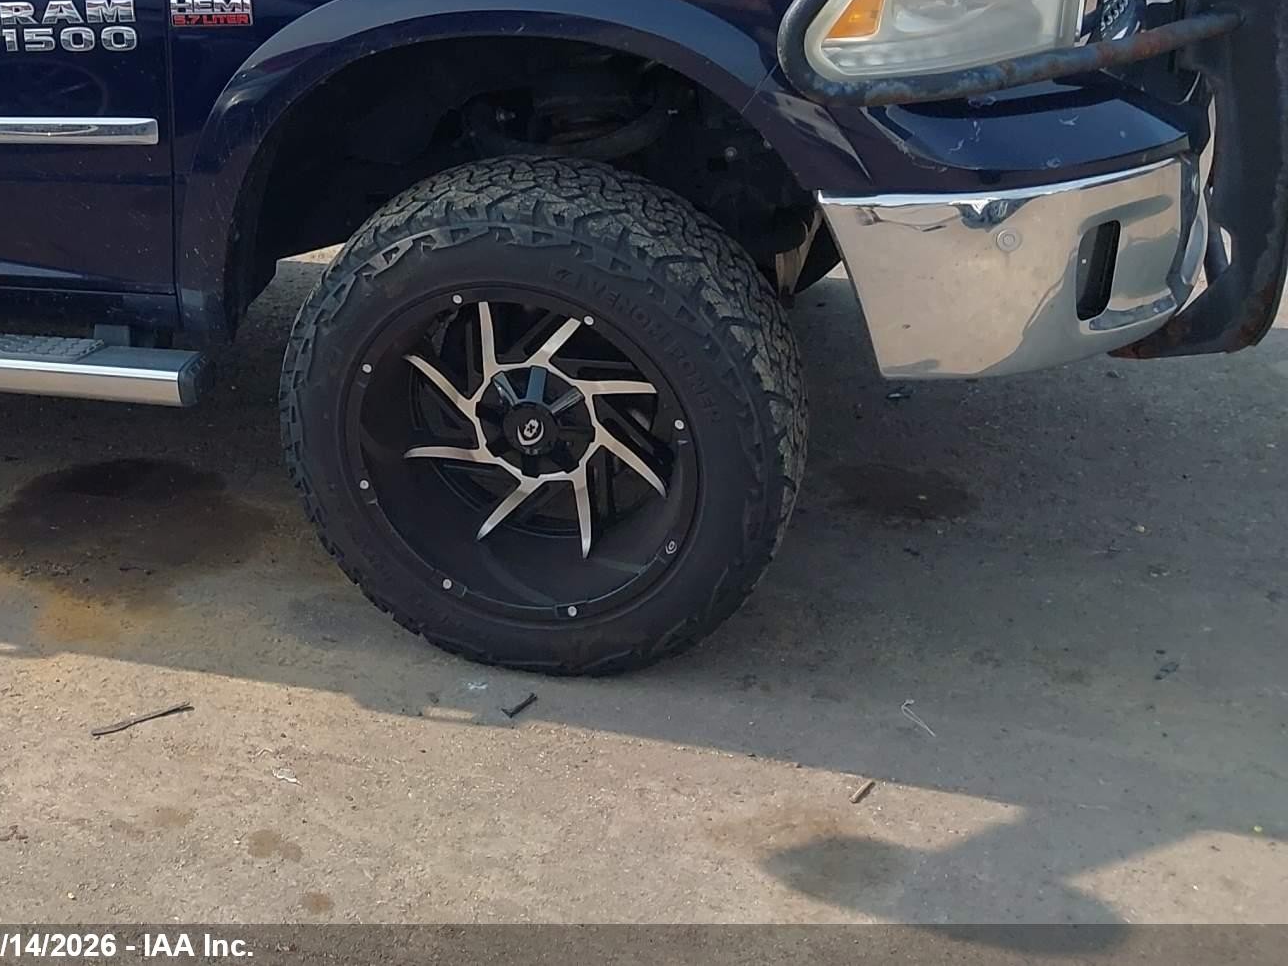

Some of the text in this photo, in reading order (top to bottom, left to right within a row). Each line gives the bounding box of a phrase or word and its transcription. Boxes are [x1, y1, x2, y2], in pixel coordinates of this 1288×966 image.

[172, 14, 249, 26] 5.7 LITER
[1, 26, 138, 53] 1500
